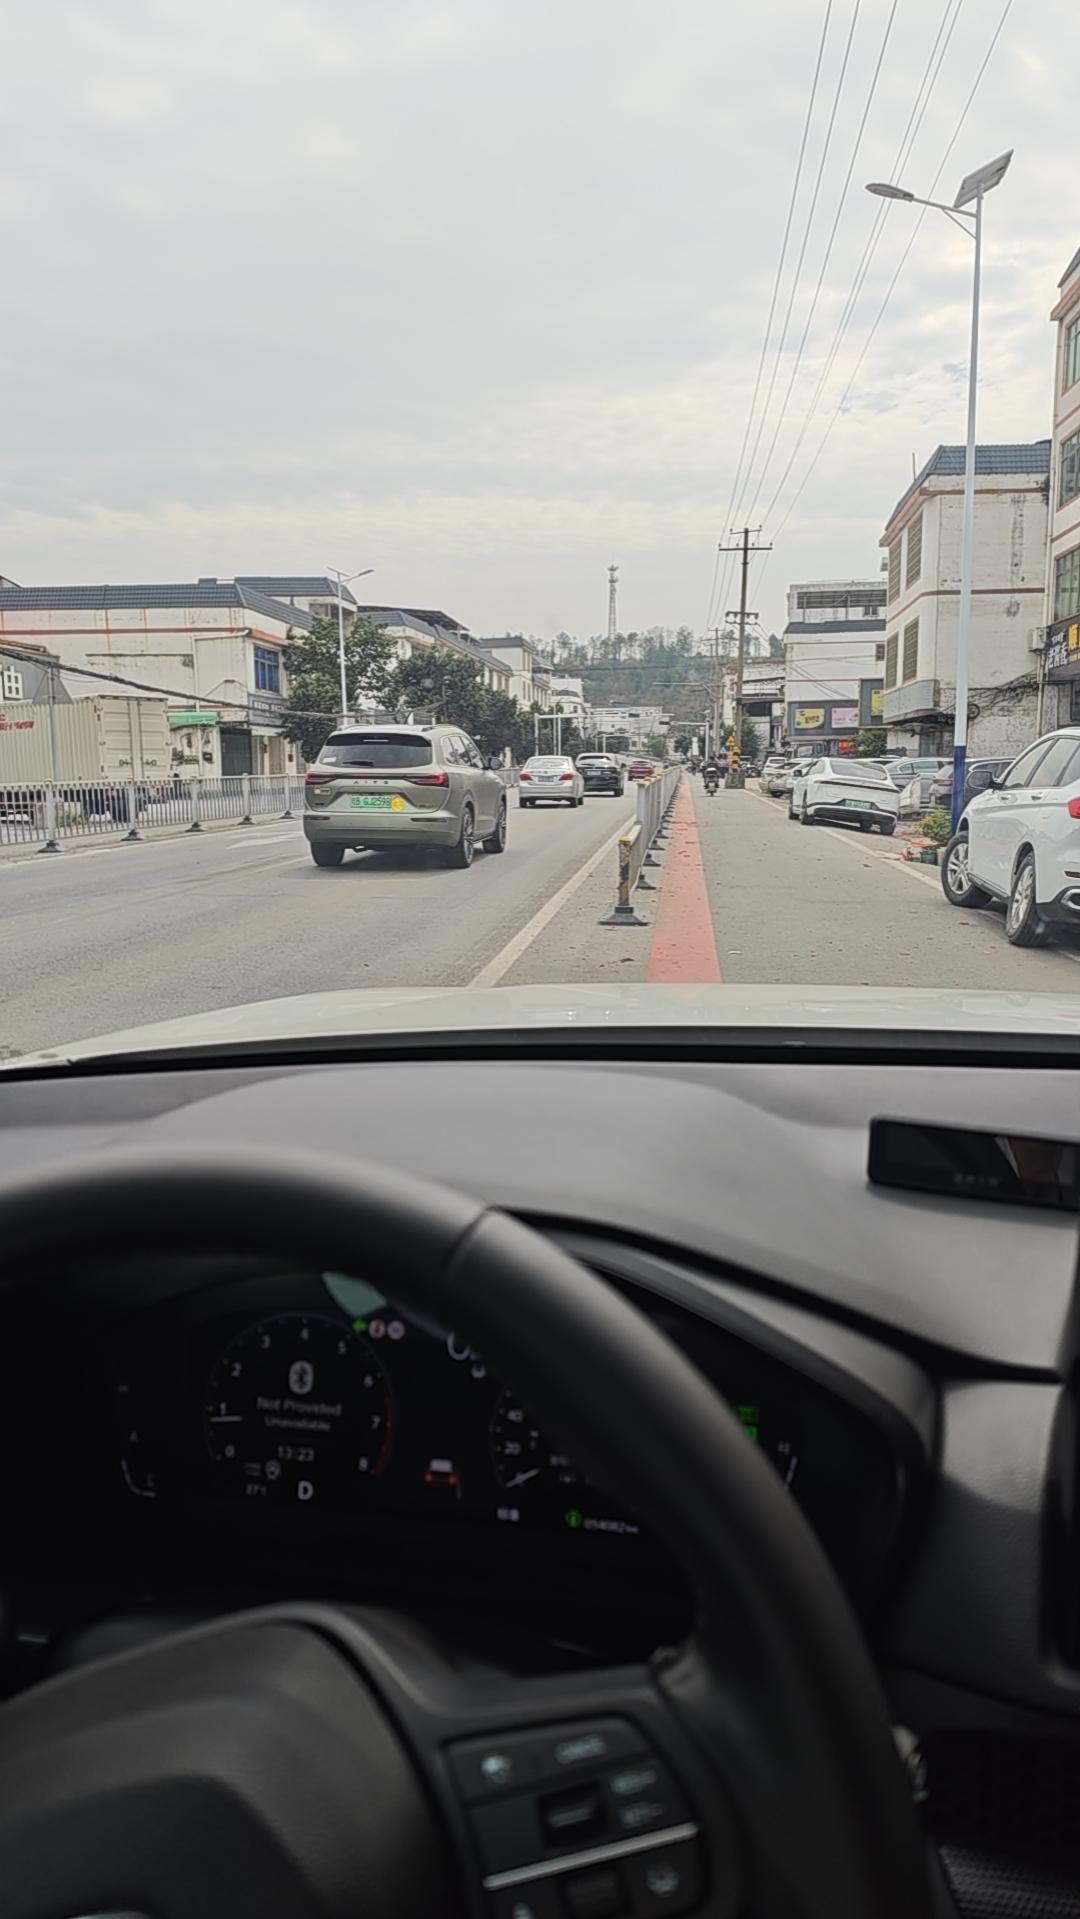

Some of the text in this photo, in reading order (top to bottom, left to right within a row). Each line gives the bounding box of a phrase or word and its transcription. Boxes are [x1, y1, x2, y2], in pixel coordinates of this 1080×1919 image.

[230, 1361, 242, 1378] 2
[257, 1396, 342, 1416] Not Provided
[277, 1445, 315, 1462] 13:23
[297, 1479, 314, 1501] D
